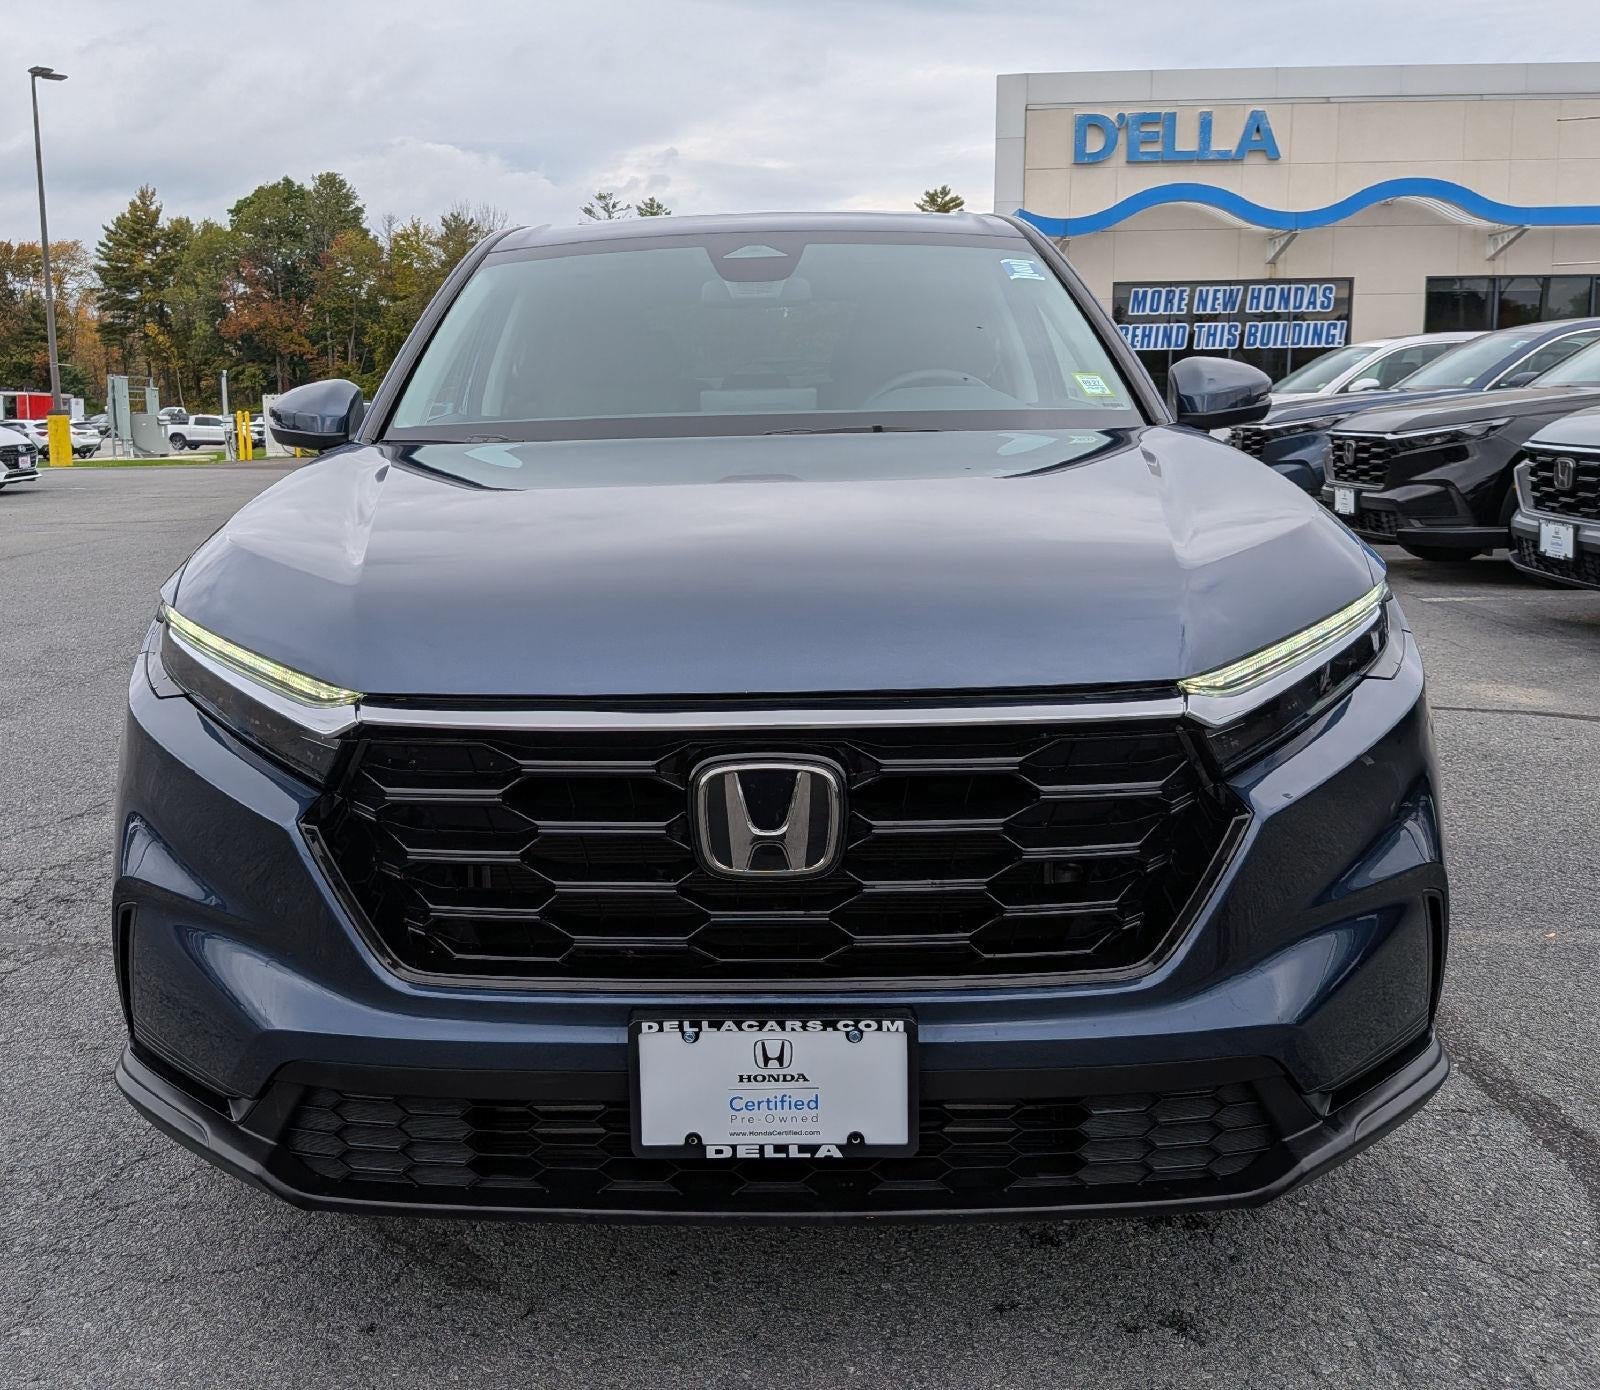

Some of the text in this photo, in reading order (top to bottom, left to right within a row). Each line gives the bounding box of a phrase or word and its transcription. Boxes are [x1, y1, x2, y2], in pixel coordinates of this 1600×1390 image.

[1072, 108, 1281, 164] D'ELLA
[1128, 284, 1335, 315] MORE NEW HONDAS
[1193, 322, 1241, 349] THIS
[1243, 320, 1347, 349] BUILDING!
[641, 1020, 904, 1033] DELLACARS.COM
[737, 1072, 810, 1084] HONDA
[729, 1094, 819, 1112] Certified
[730, 1113, 819, 1125] Pre-Owned
[729, 1129, 821, 1137] www.HondaCertified.com
[706, 1144, 844, 1159] DELLA
